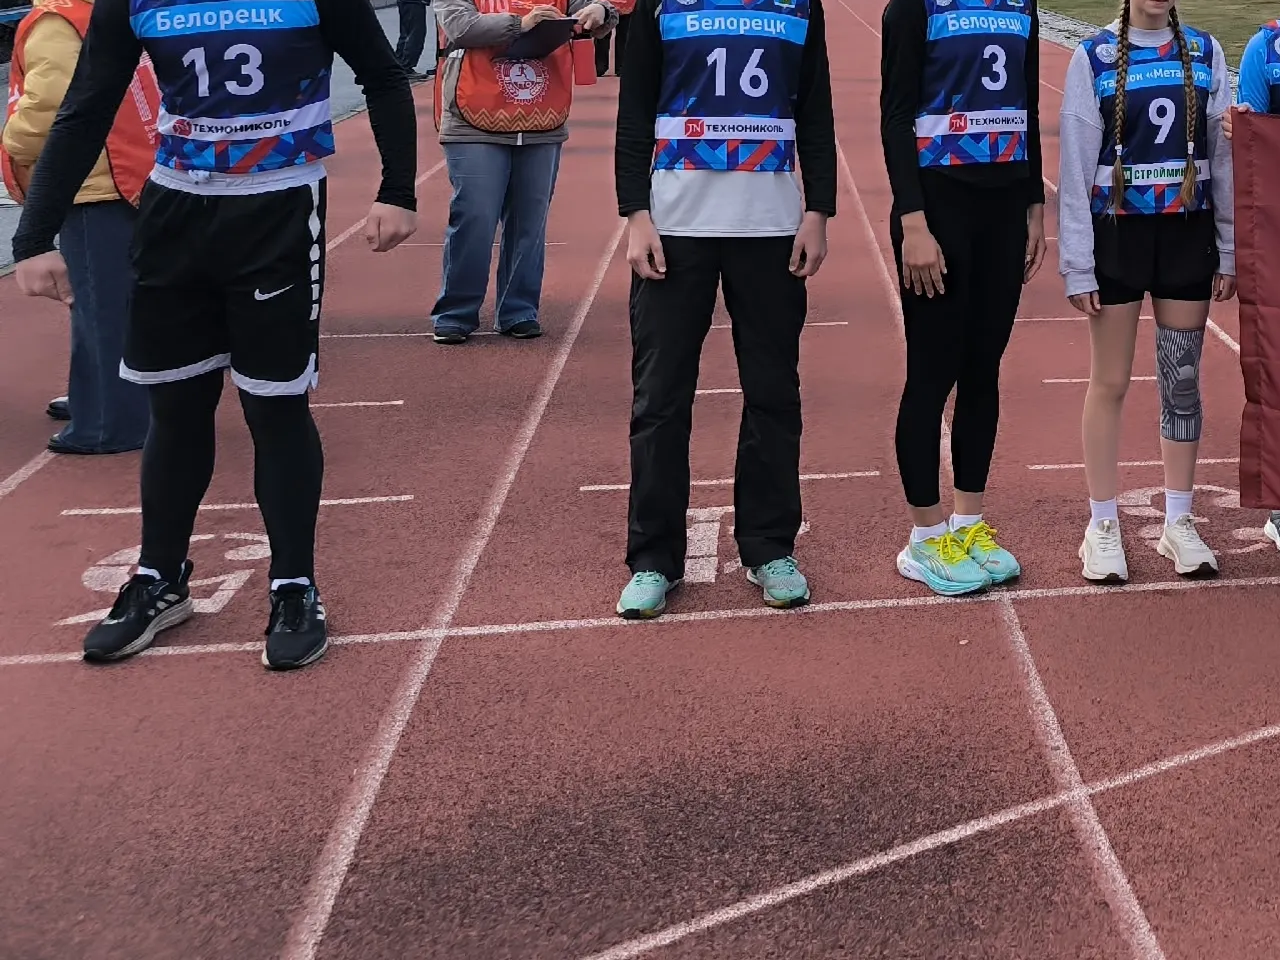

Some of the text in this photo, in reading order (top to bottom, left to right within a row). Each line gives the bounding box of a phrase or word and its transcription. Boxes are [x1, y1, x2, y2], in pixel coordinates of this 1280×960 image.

[156, 8, 284, 31] Белорецк
[686, 14, 786, 35] Белорецк
[947, 14, 1022, 32] Белорецк
[181, 43, 265, 98] 13
[706, 47, 769, 98] 16
[981, 44, 1008, 91] 3
[192, 119, 292, 135] ТЕХНОНИКОЛЬ
[706, 124, 784, 133] ТЕХНОНИКОЛЬ
[1148, 97, 1176, 144] 9
